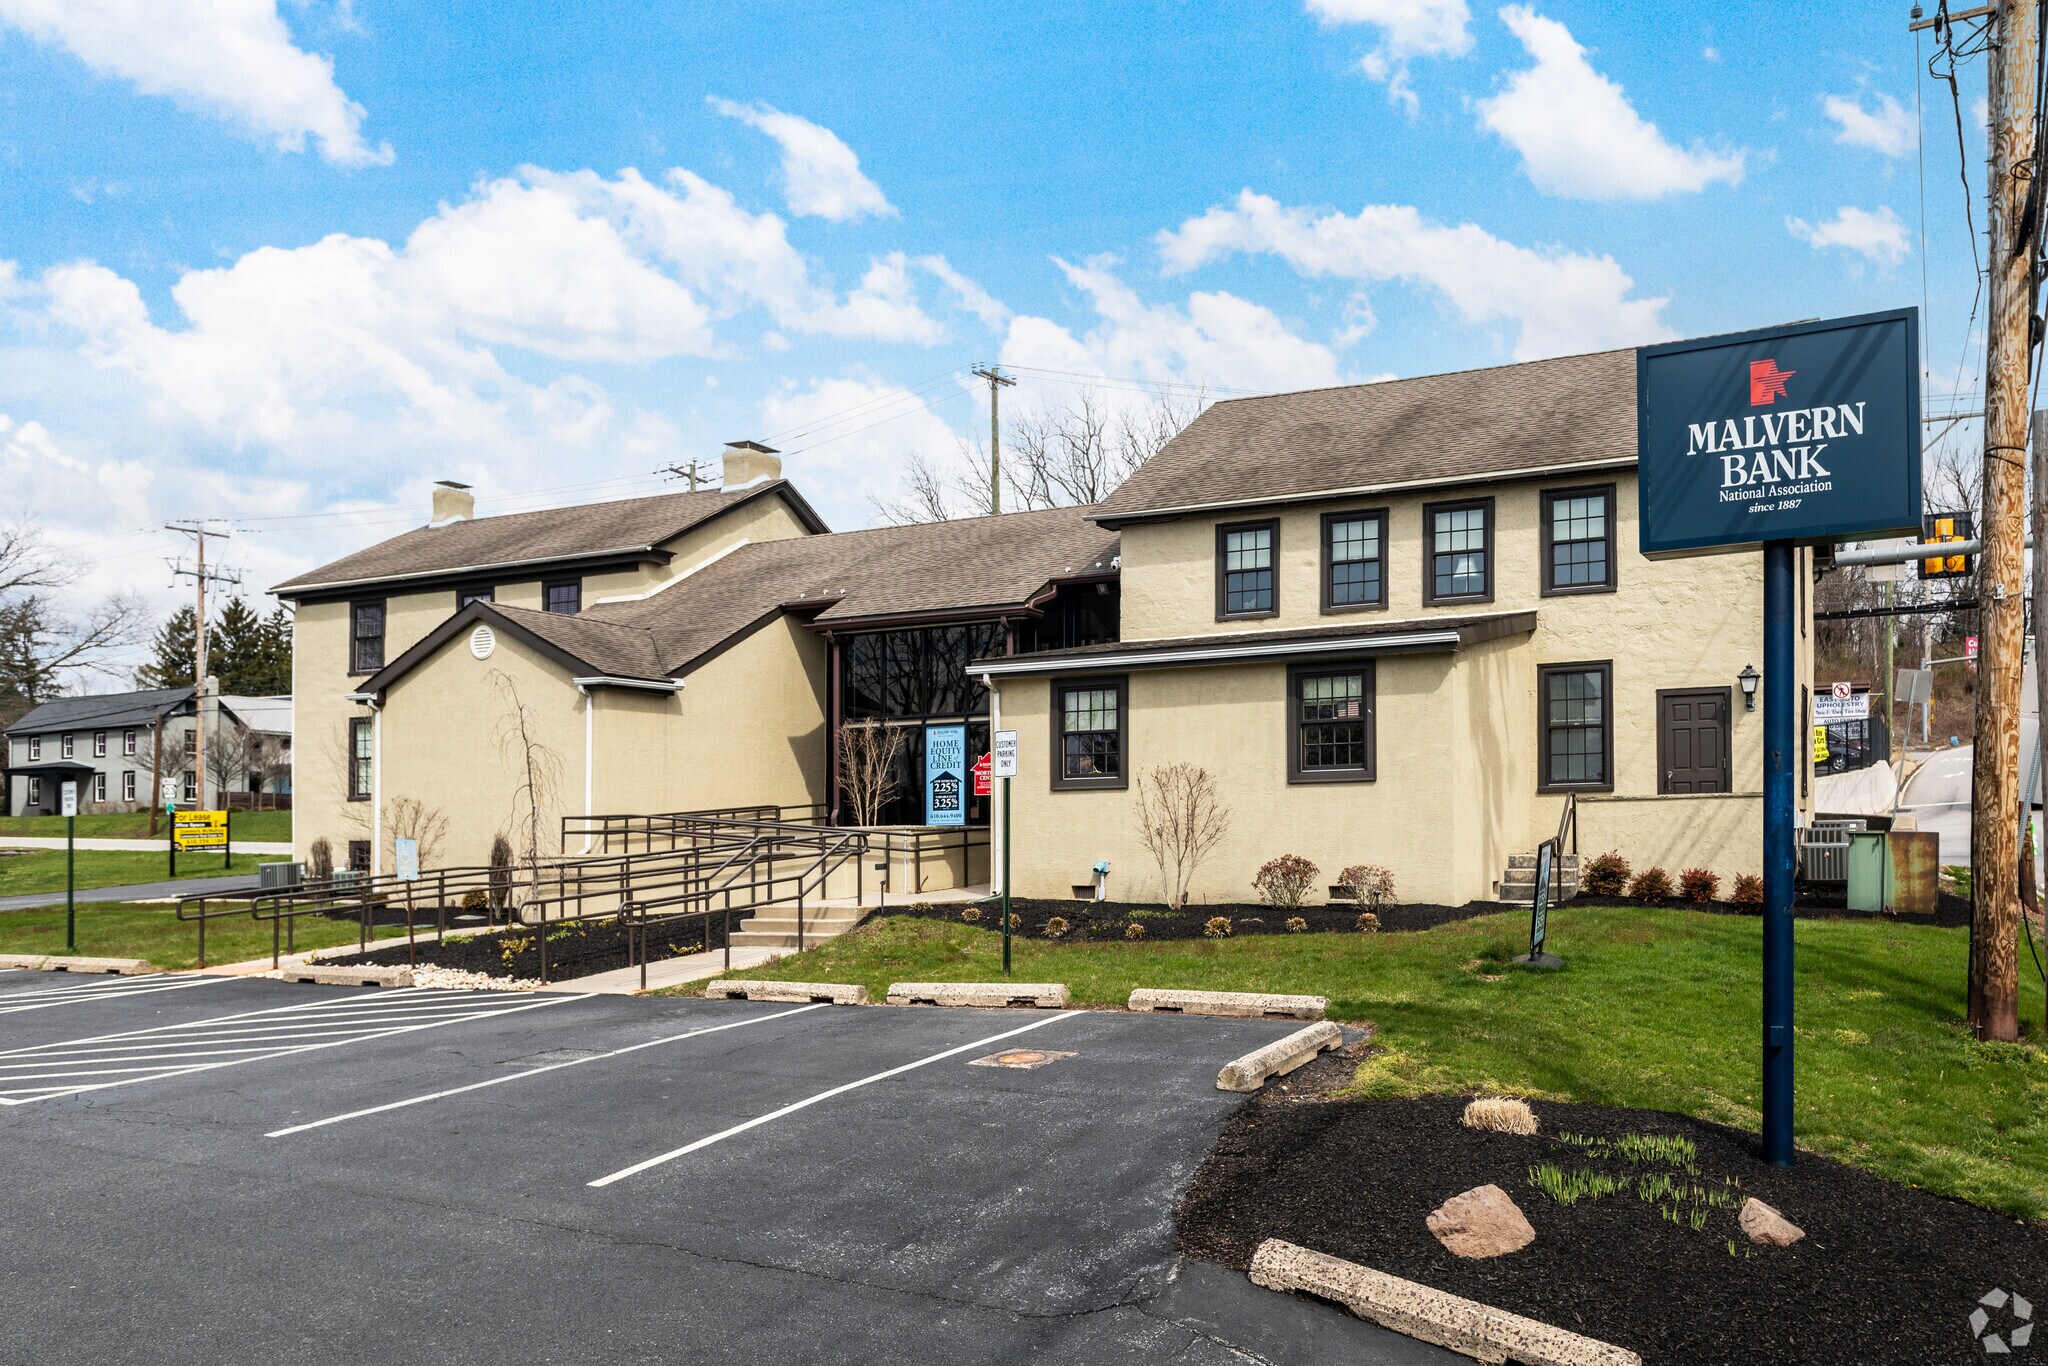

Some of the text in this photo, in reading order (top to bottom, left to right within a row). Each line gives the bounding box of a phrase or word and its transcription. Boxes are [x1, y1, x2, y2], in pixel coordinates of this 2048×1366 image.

[1687, 401, 1866, 456] MALVERN
[1720, 443, 1831, 488] BANK
[1719, 480, 1832, 502] National Association
[1748, 499, 1802, 514] since 1887
[996, 740, 1016, 748] CUSTOMER
[930, 747, 961, 756] EQUITY
[997, 750, 1015, 758] PARKING
[932, 755, 953, 763] LINE
[930, 761, 961, 769] CREDIT
[189, 812, 211, 821] Lease
